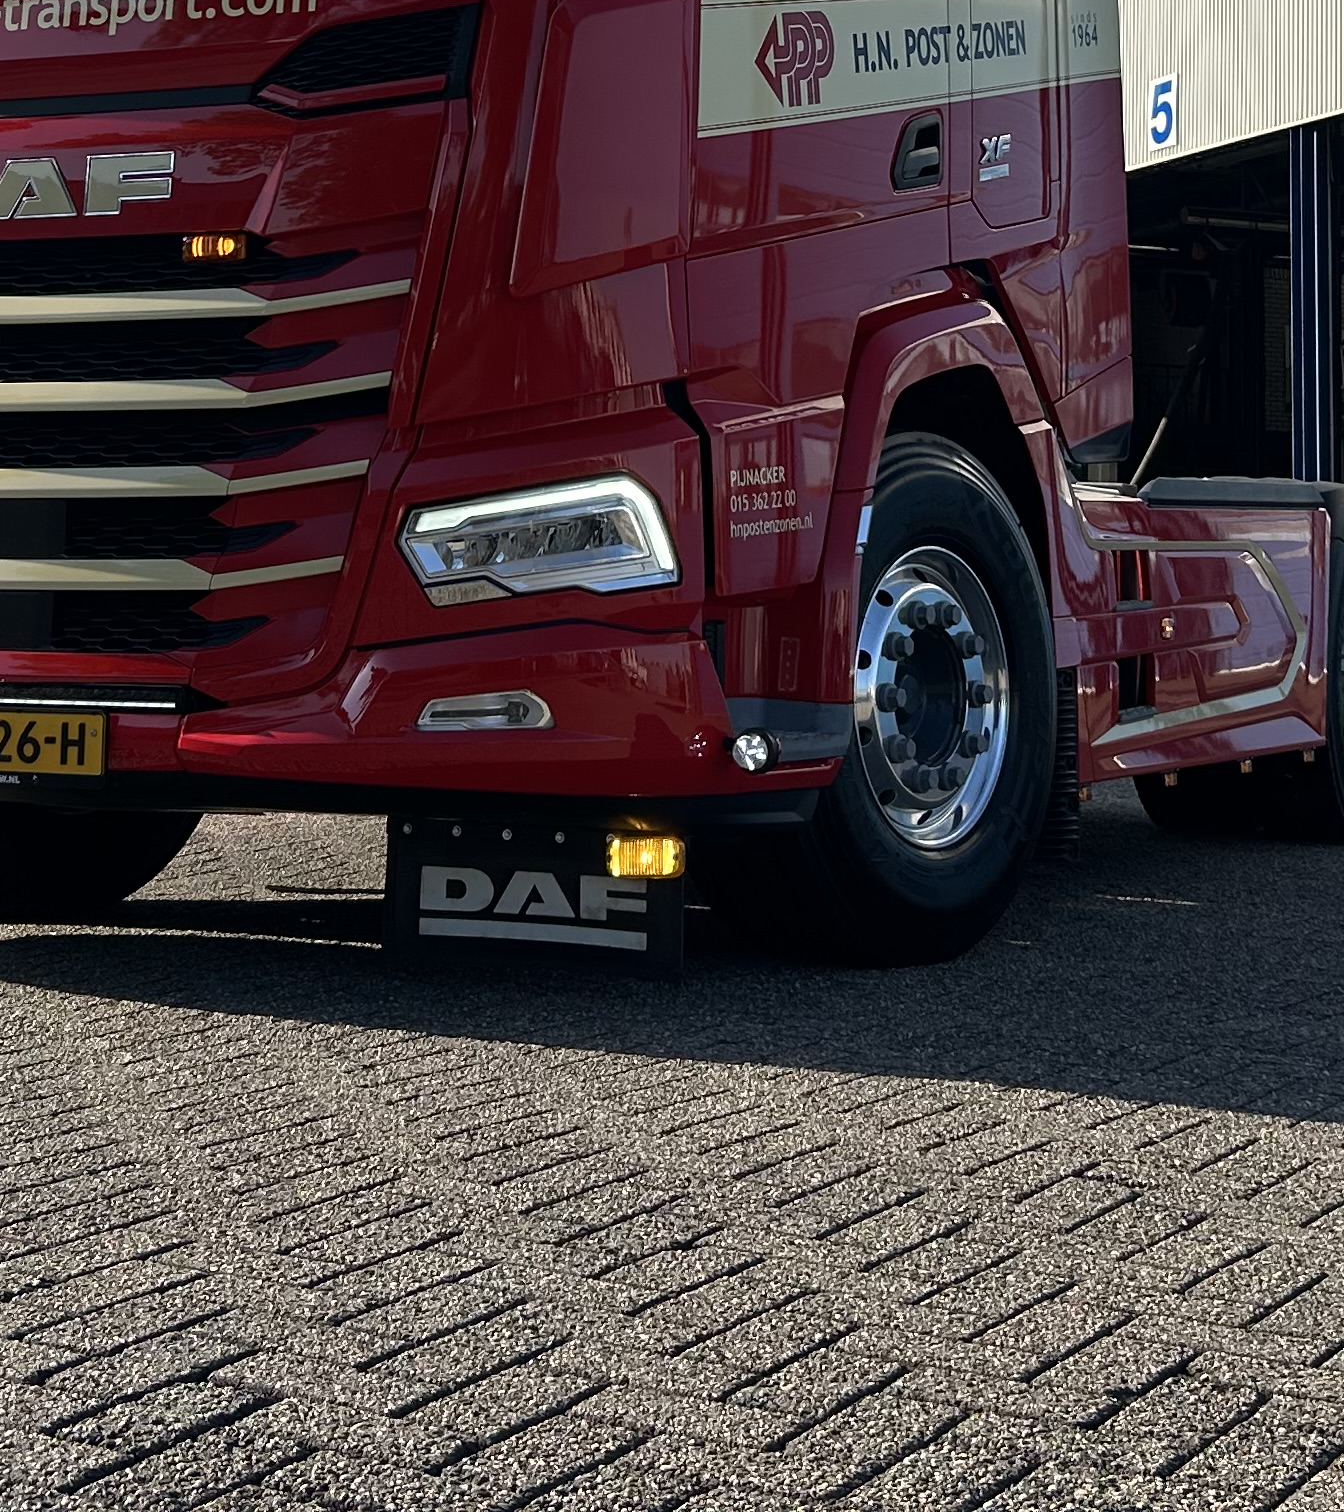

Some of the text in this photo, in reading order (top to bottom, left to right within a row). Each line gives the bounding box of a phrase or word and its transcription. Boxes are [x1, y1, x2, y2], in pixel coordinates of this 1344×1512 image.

[852, 19, 1027, 74] H.N. POST & ZONEN
[1071, 23, 1099, 49] 1964
[1149, 79, 1174, 146] 5
[978, 133, 1012, 165] XF
[730, 465, 786, 488] PIJNACKER
[730, 489, 797, 512] 015 362 22 00
[730, 512, 813, 540] hnpostenzonen.nl
[419, 865, 648, 921] DAF
